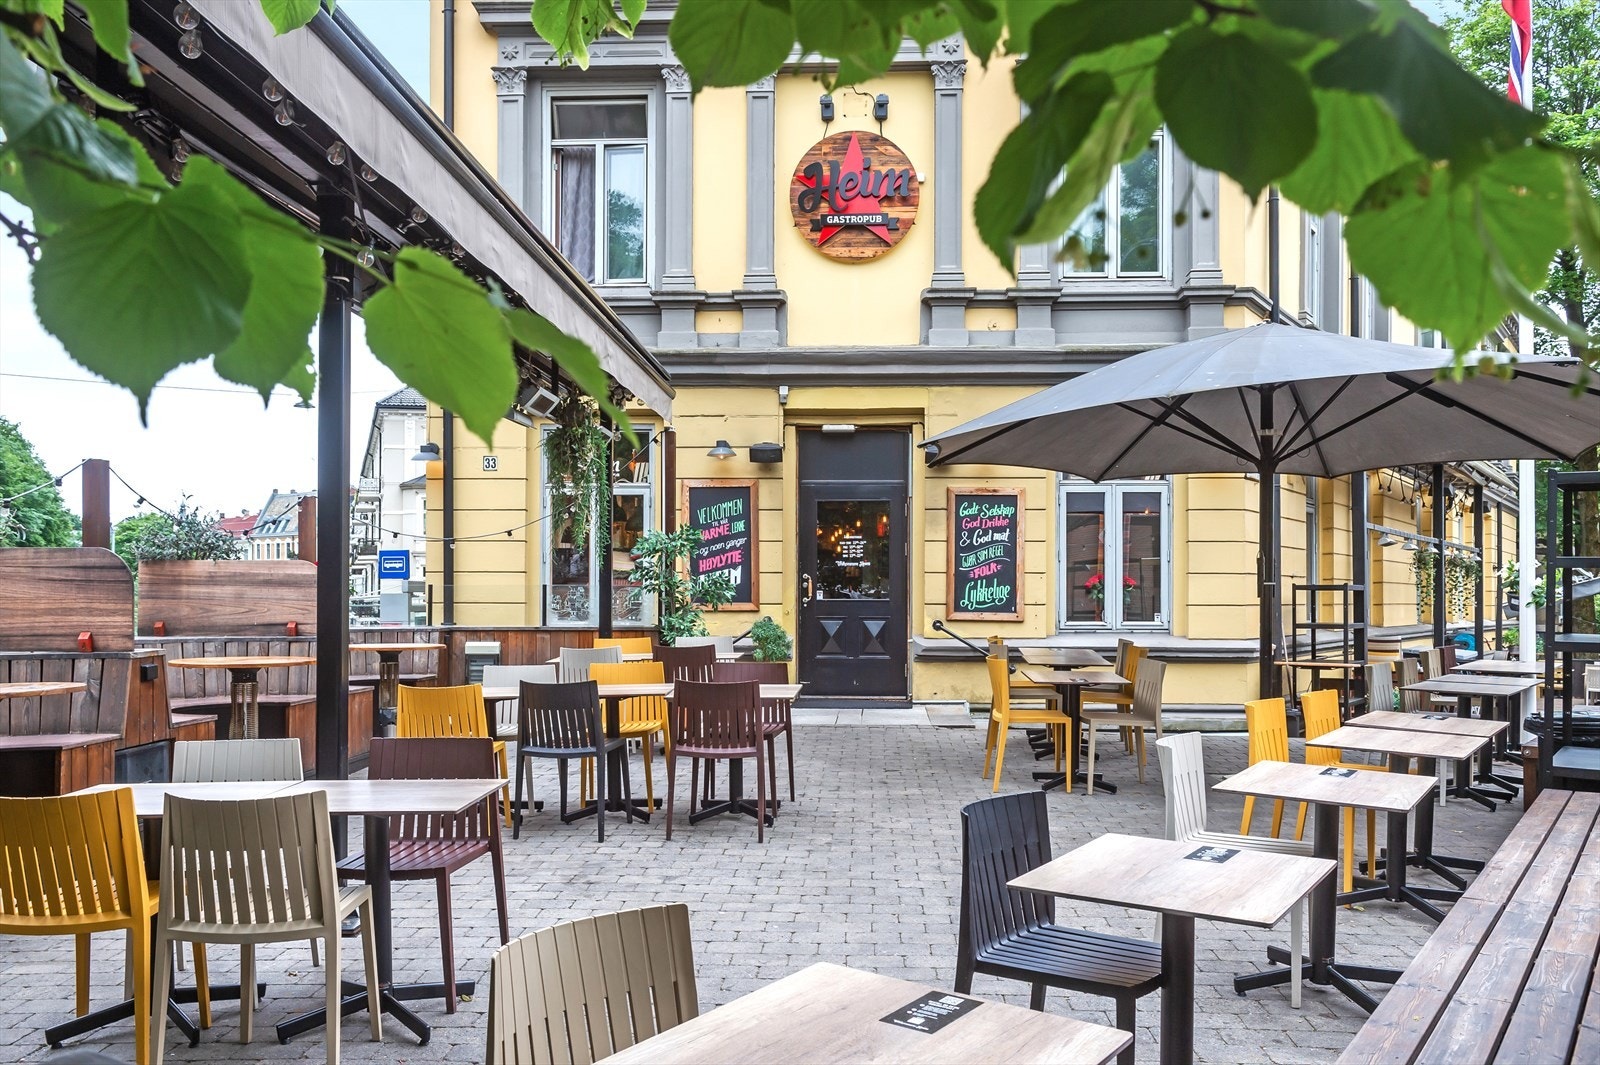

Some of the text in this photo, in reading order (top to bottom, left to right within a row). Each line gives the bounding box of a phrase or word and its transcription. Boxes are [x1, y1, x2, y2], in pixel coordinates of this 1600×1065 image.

[798, 157, 911, 213] Heim
[827, 215, 883, 224] GASTROPUB
[485, 458, 497, 469] 33
[697, 498, 743, 525] VELKOMMEN
[959, 501, 1015, 519] Godt Selskap
[962, 515, 1010, 530] God Drikke
[959, 528, 1011, 547] & God mat
[699, 546, 709, 557] og
[709, 542, 725, 552] noen
[977, 549, 988, 563] SOM
[988, 545, 1004, 559] REGEL
[698, 550, 742, 572] HØYLYTTE
[972, 562, 998, 579] FOLK
[960, 578, 1011, 610] Lykkelige
